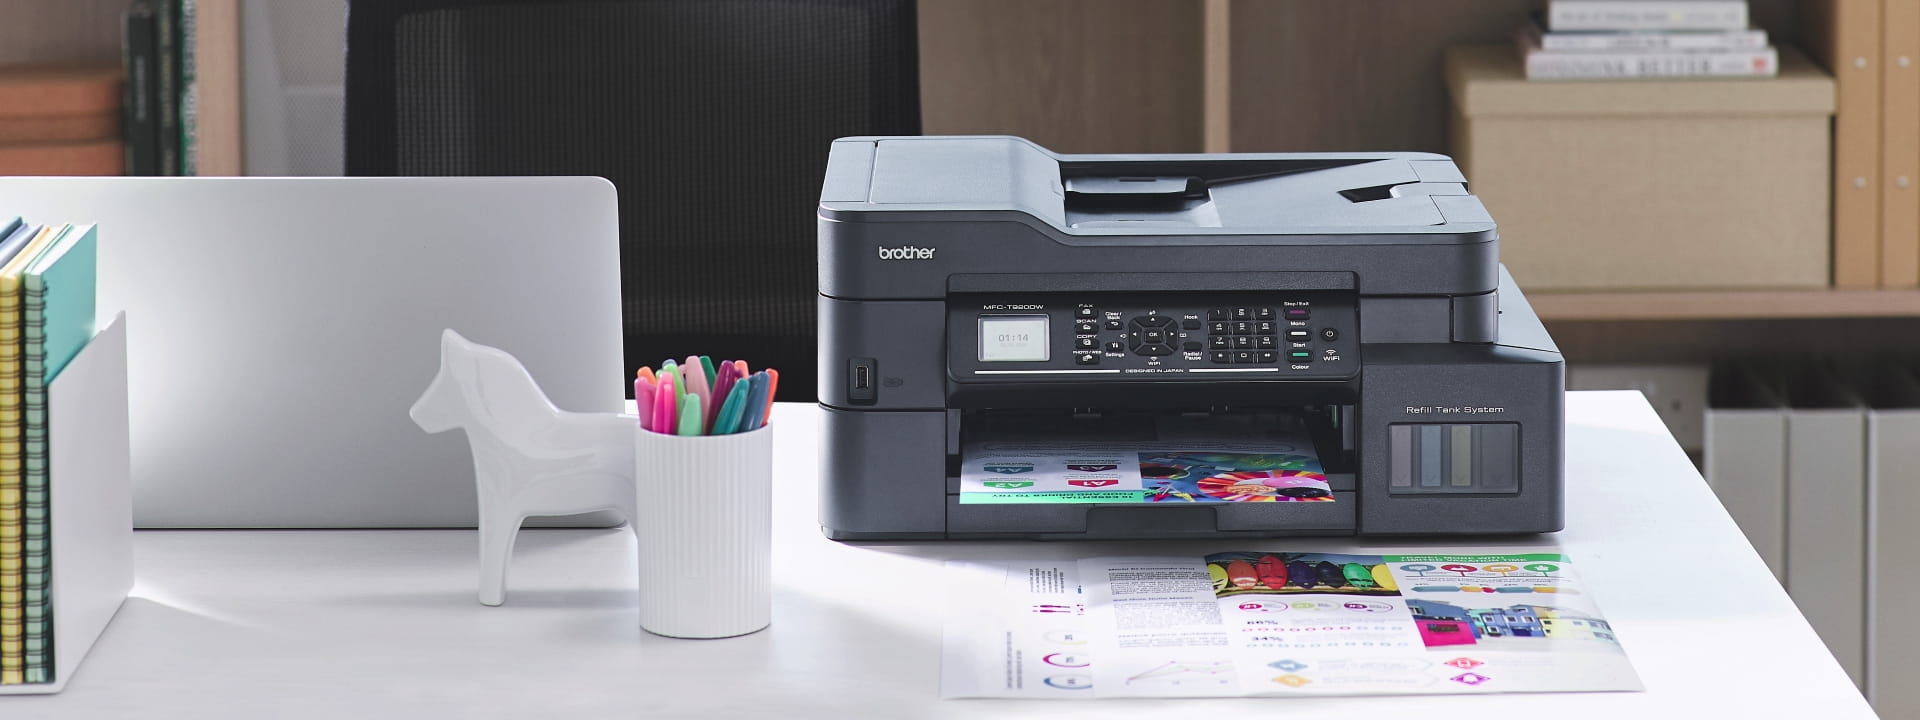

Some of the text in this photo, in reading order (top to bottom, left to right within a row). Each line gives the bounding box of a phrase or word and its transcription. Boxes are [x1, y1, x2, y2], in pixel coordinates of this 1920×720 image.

[879, 246, 935, 259] brother
[998, 334, 1029, 342] 01:14
[1406, 406, 1504, 415] Refill Tank System
